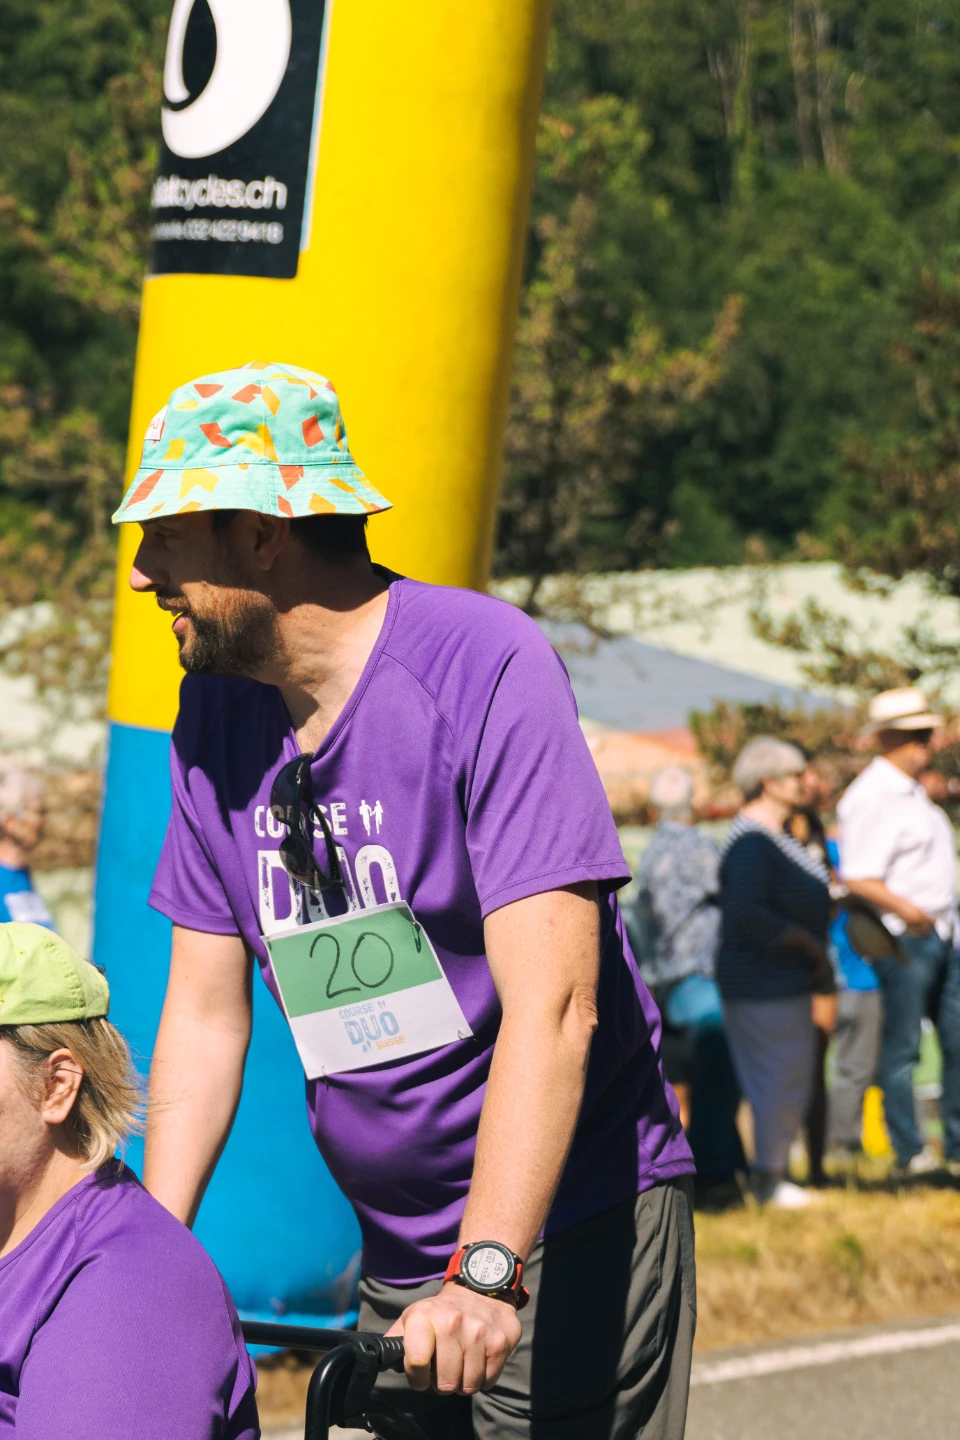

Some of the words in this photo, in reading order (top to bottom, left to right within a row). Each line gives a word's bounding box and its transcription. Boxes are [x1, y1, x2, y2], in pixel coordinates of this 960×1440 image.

[254, 803, 348, 838] COSE
[310, 931, 394, 999] 20
[339, 1002, 375, 1019] COURSE
[344, 1011, 400, 1045] DUO
[375, 1035, 406, 1050] SUISSE
